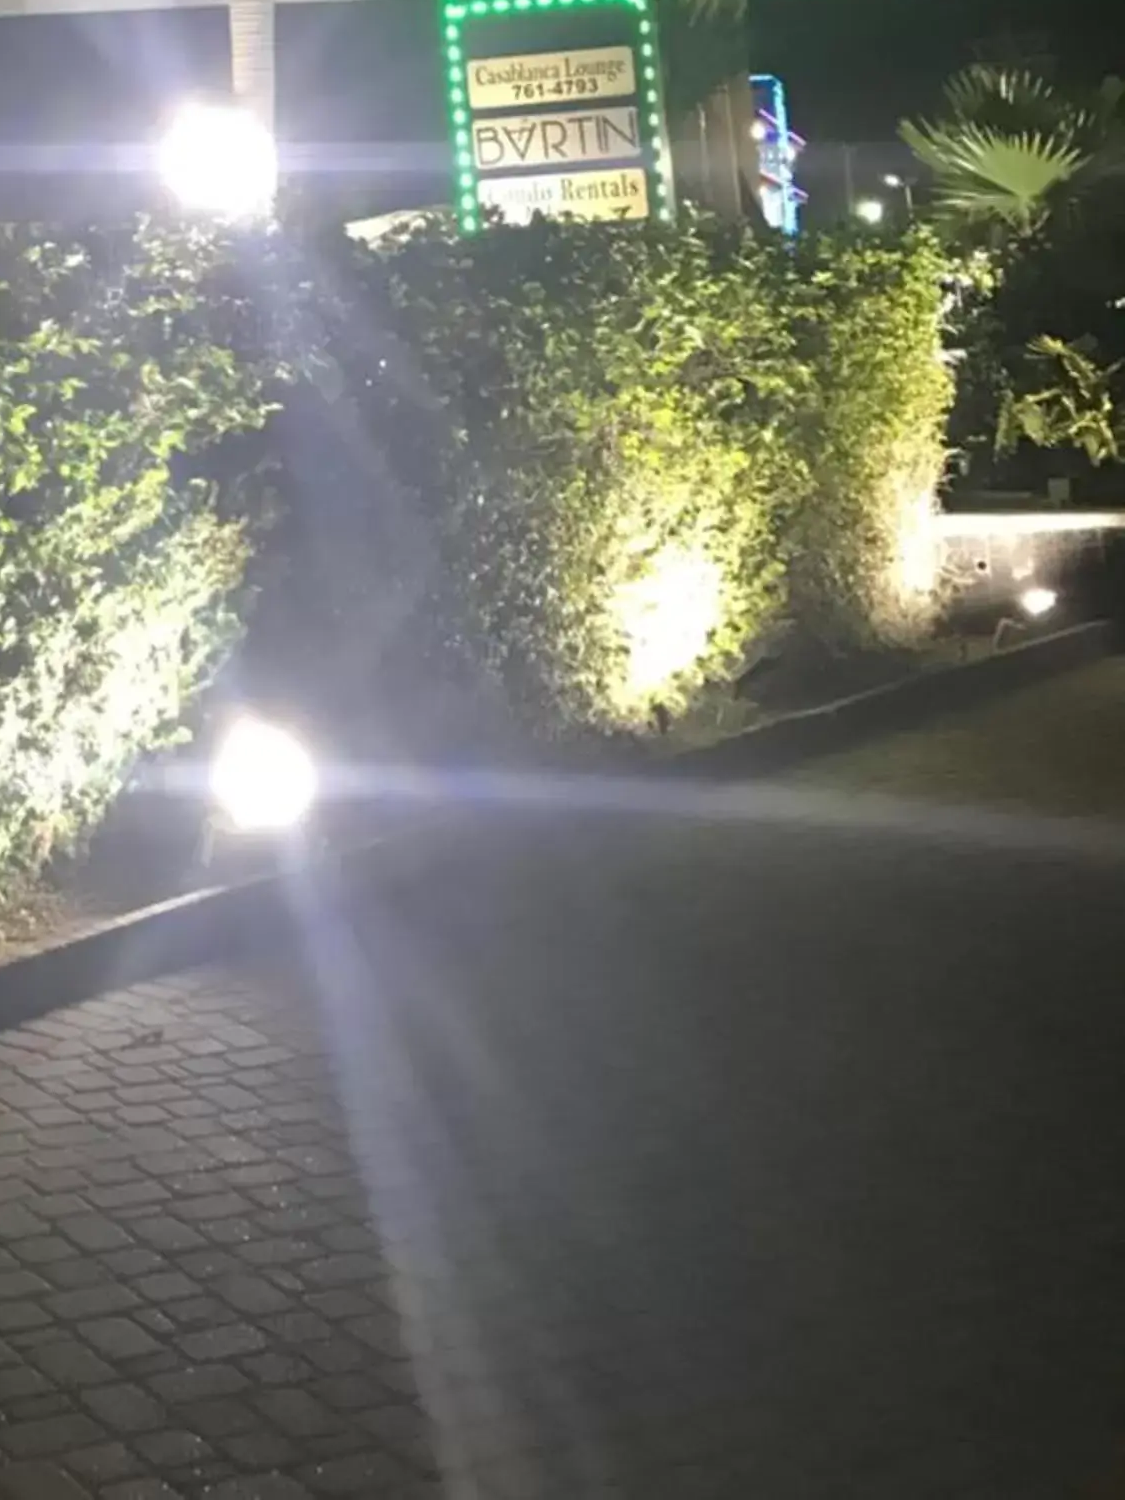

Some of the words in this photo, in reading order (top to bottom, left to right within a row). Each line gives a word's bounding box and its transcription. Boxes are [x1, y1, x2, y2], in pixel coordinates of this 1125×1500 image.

[475, 62, 560, 86] Casablanca
[564, 57, 627, 82] Lounge
[511, 78, 599, 100] 761-4793
[486, 180, 554, 204] ndo
[560, 172, 640, 202] Rentals
